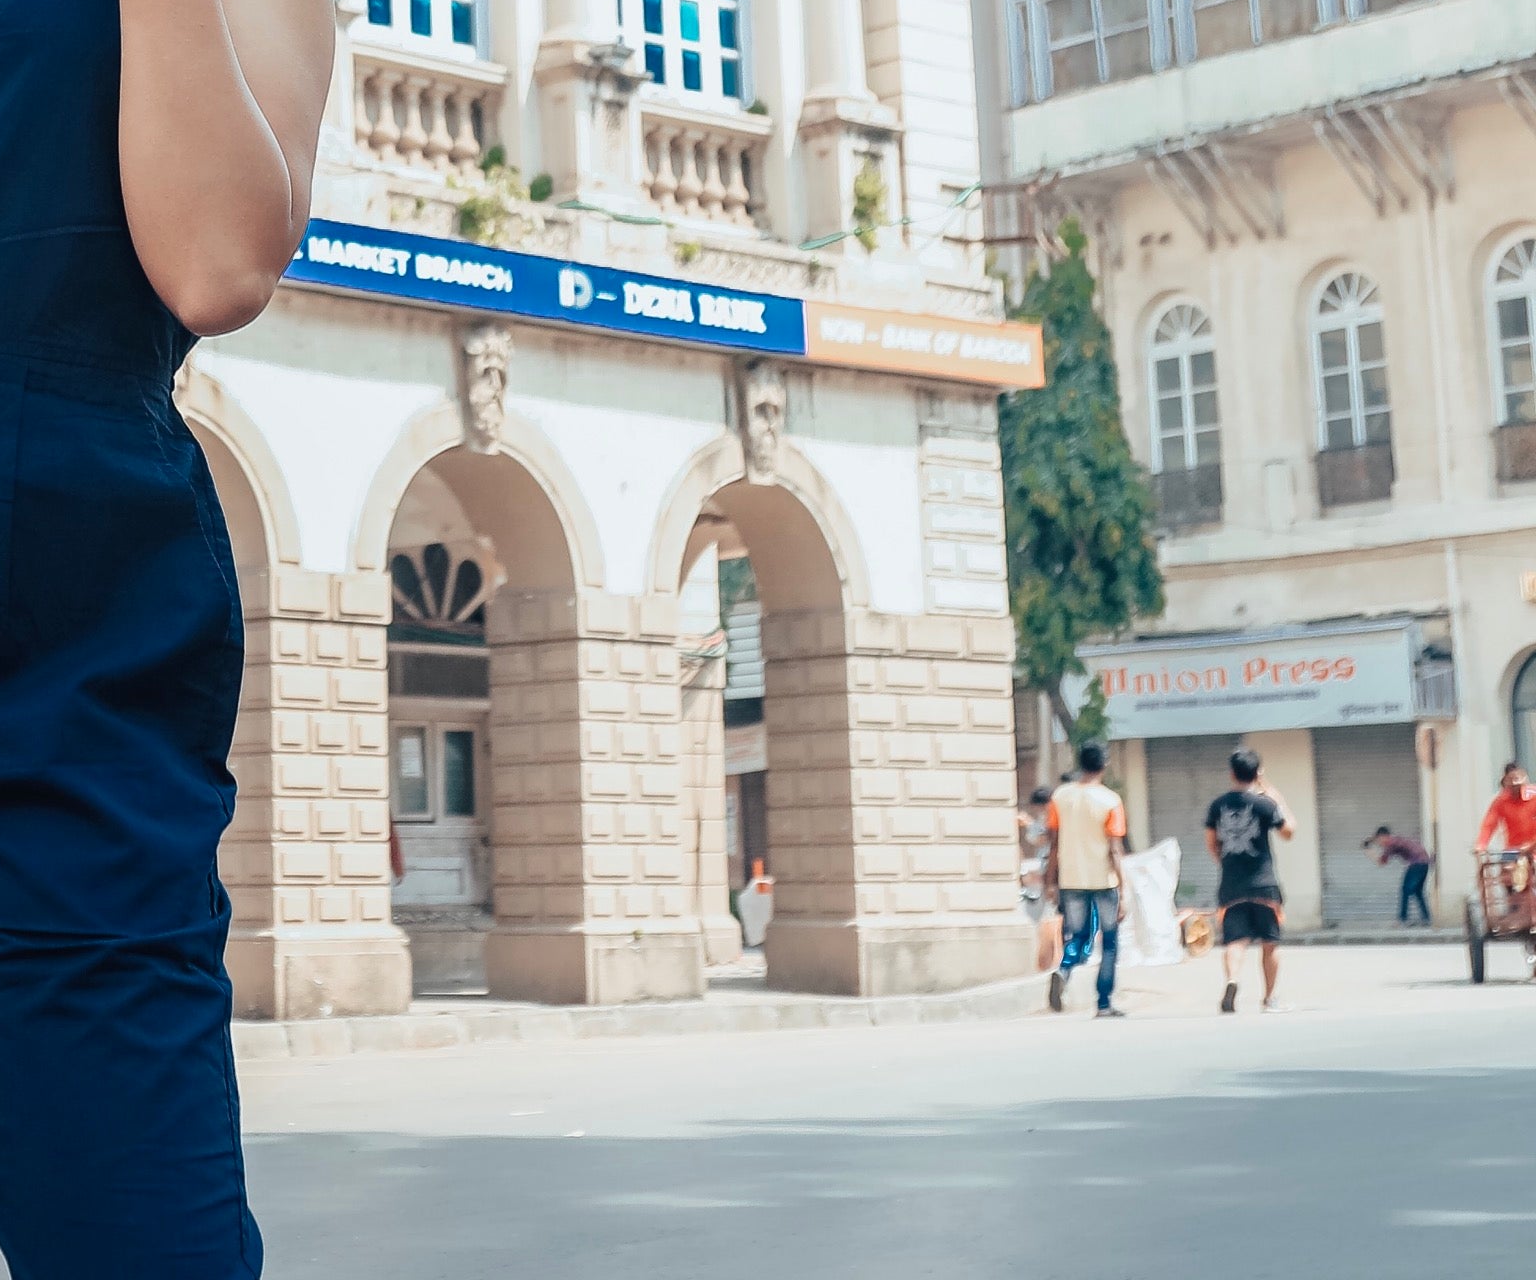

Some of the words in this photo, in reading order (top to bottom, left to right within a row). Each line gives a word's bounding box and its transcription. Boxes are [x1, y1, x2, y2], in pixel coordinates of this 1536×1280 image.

[308, 236, 411, 277] MARKET
[415, 252, 513, 293] BRANCH
[1243, 656, 1357, 686] Press
